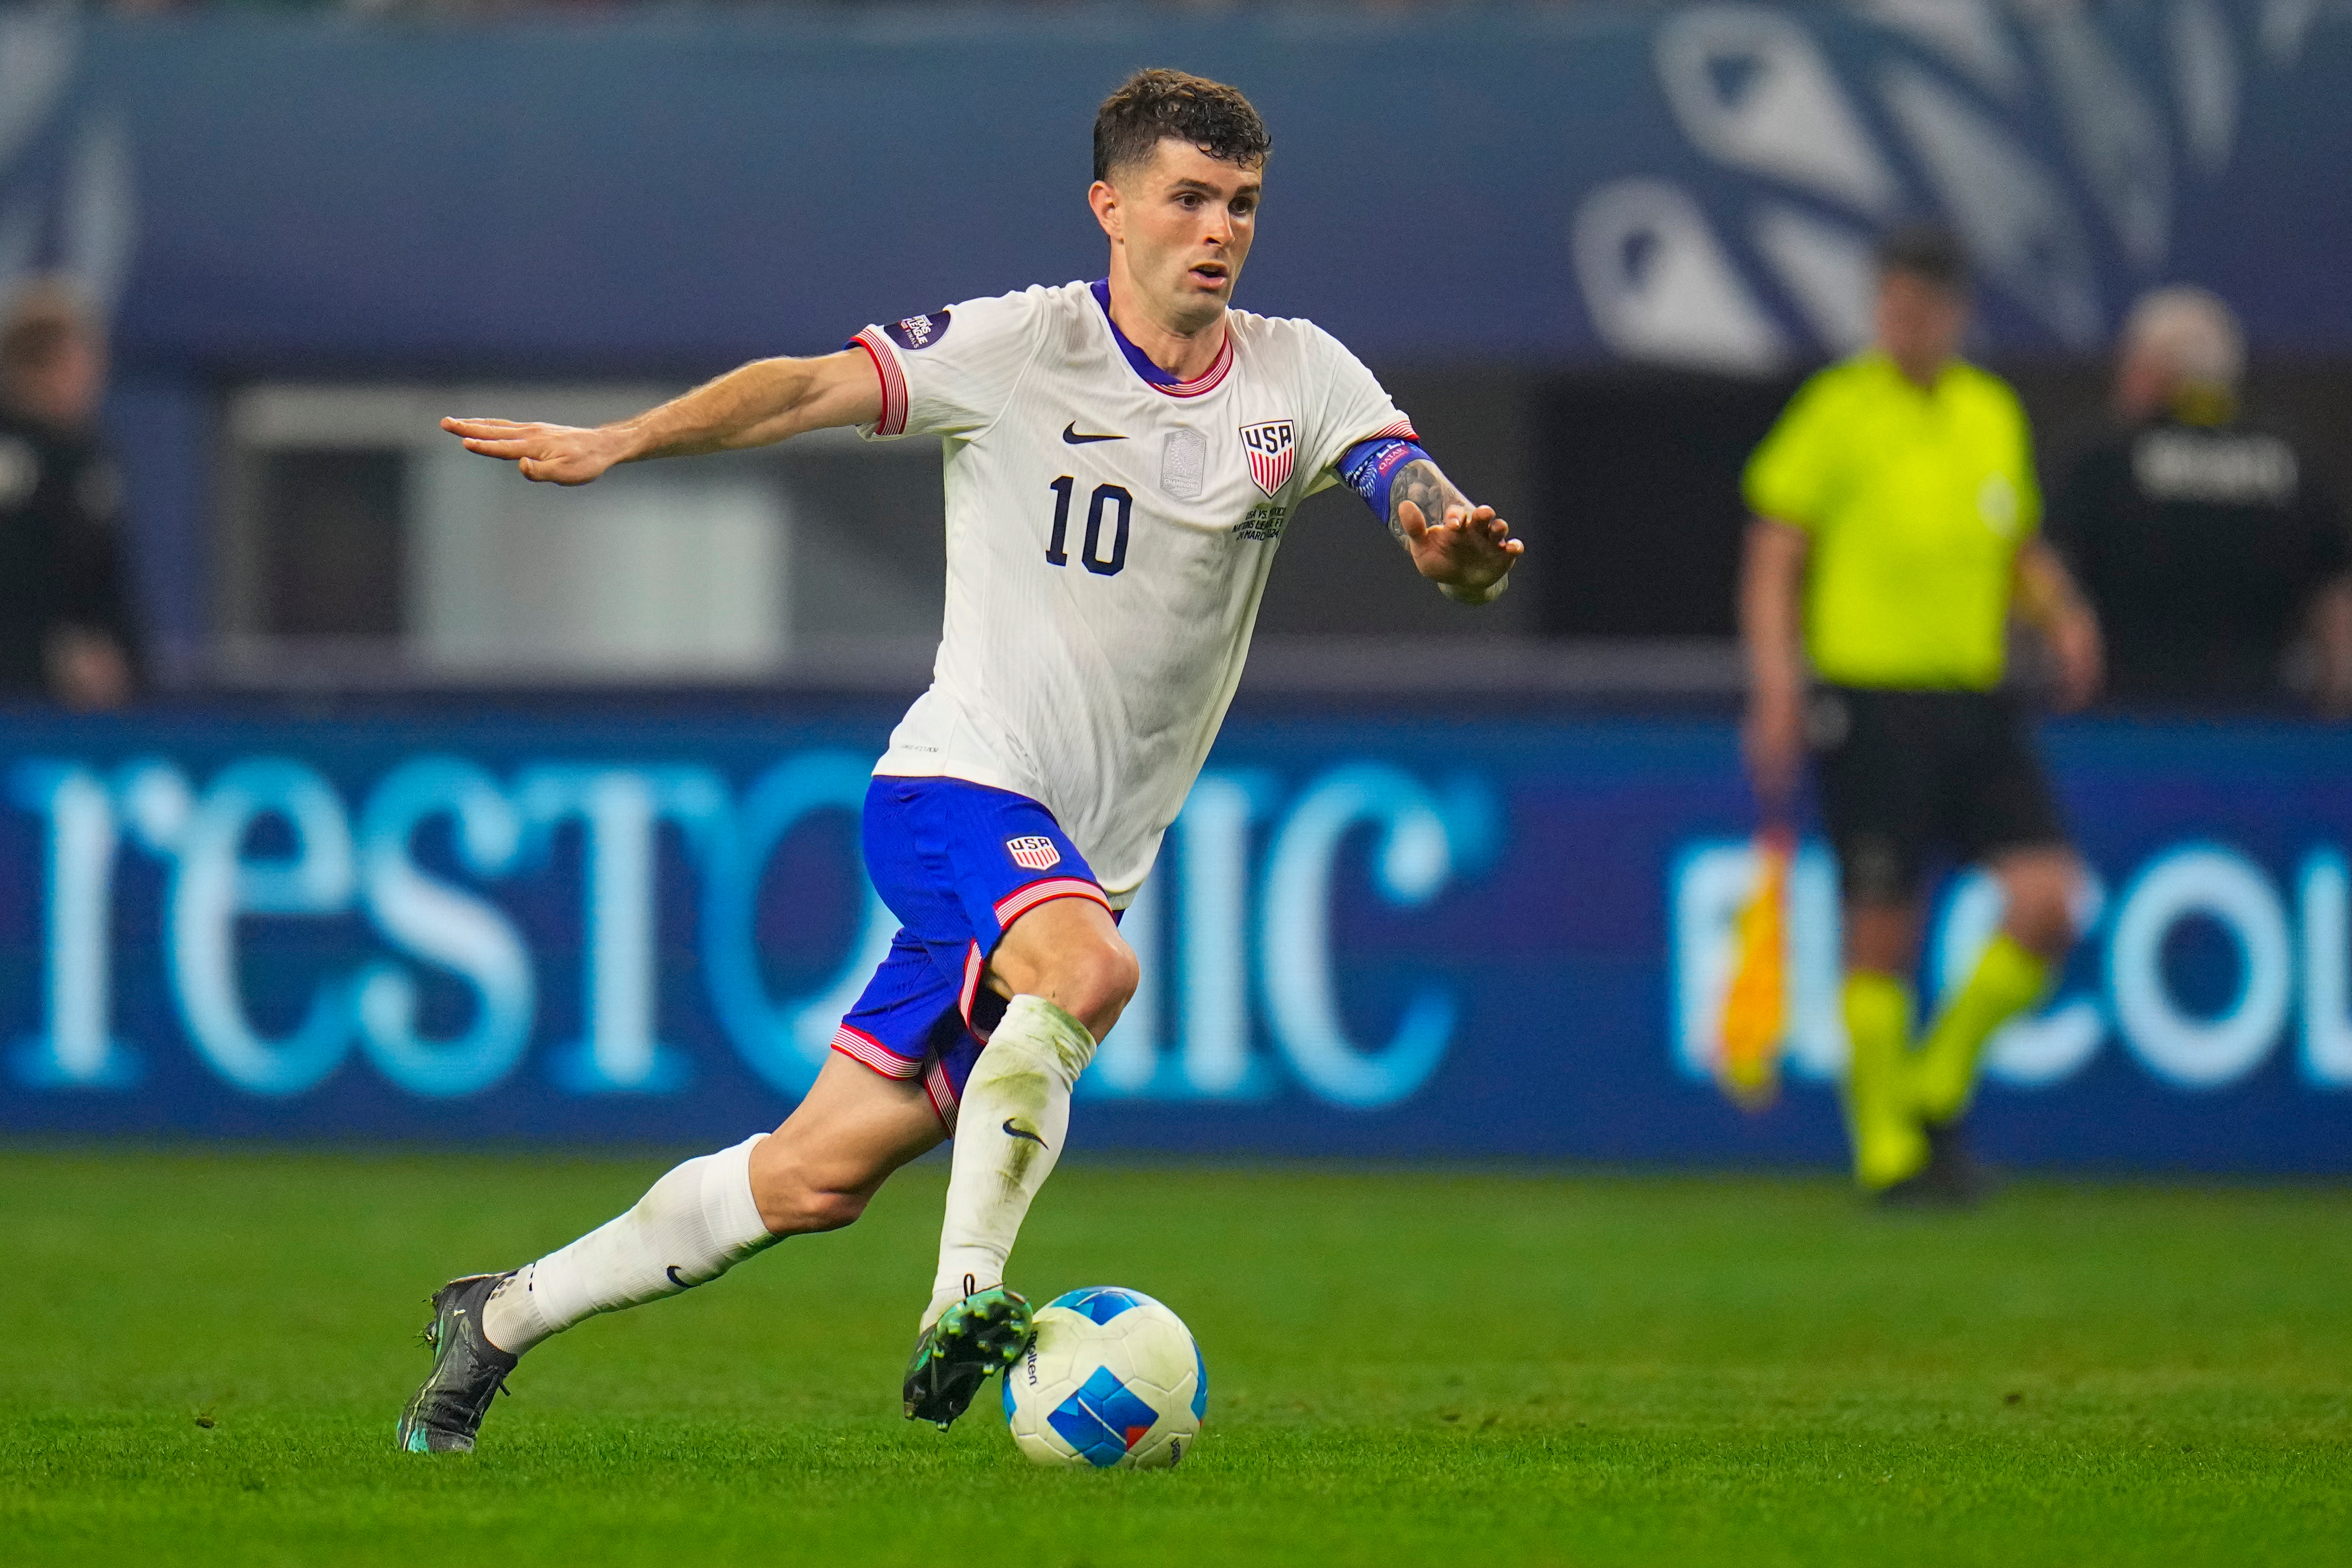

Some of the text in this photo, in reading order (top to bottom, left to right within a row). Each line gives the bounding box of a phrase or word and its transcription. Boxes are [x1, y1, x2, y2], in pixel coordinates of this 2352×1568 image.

[905, 329, 919, 348] FINALS
[907, 319, 928, 344] LEAGUE
[1245, 425, 1292, 454] USA
[1379, 447, 1405, 470] QATAR
[1046, 476, 1133, 577] 10
[1244, 530, 1265, 541] MARC
[1010, 838, 1050, 850] USA
